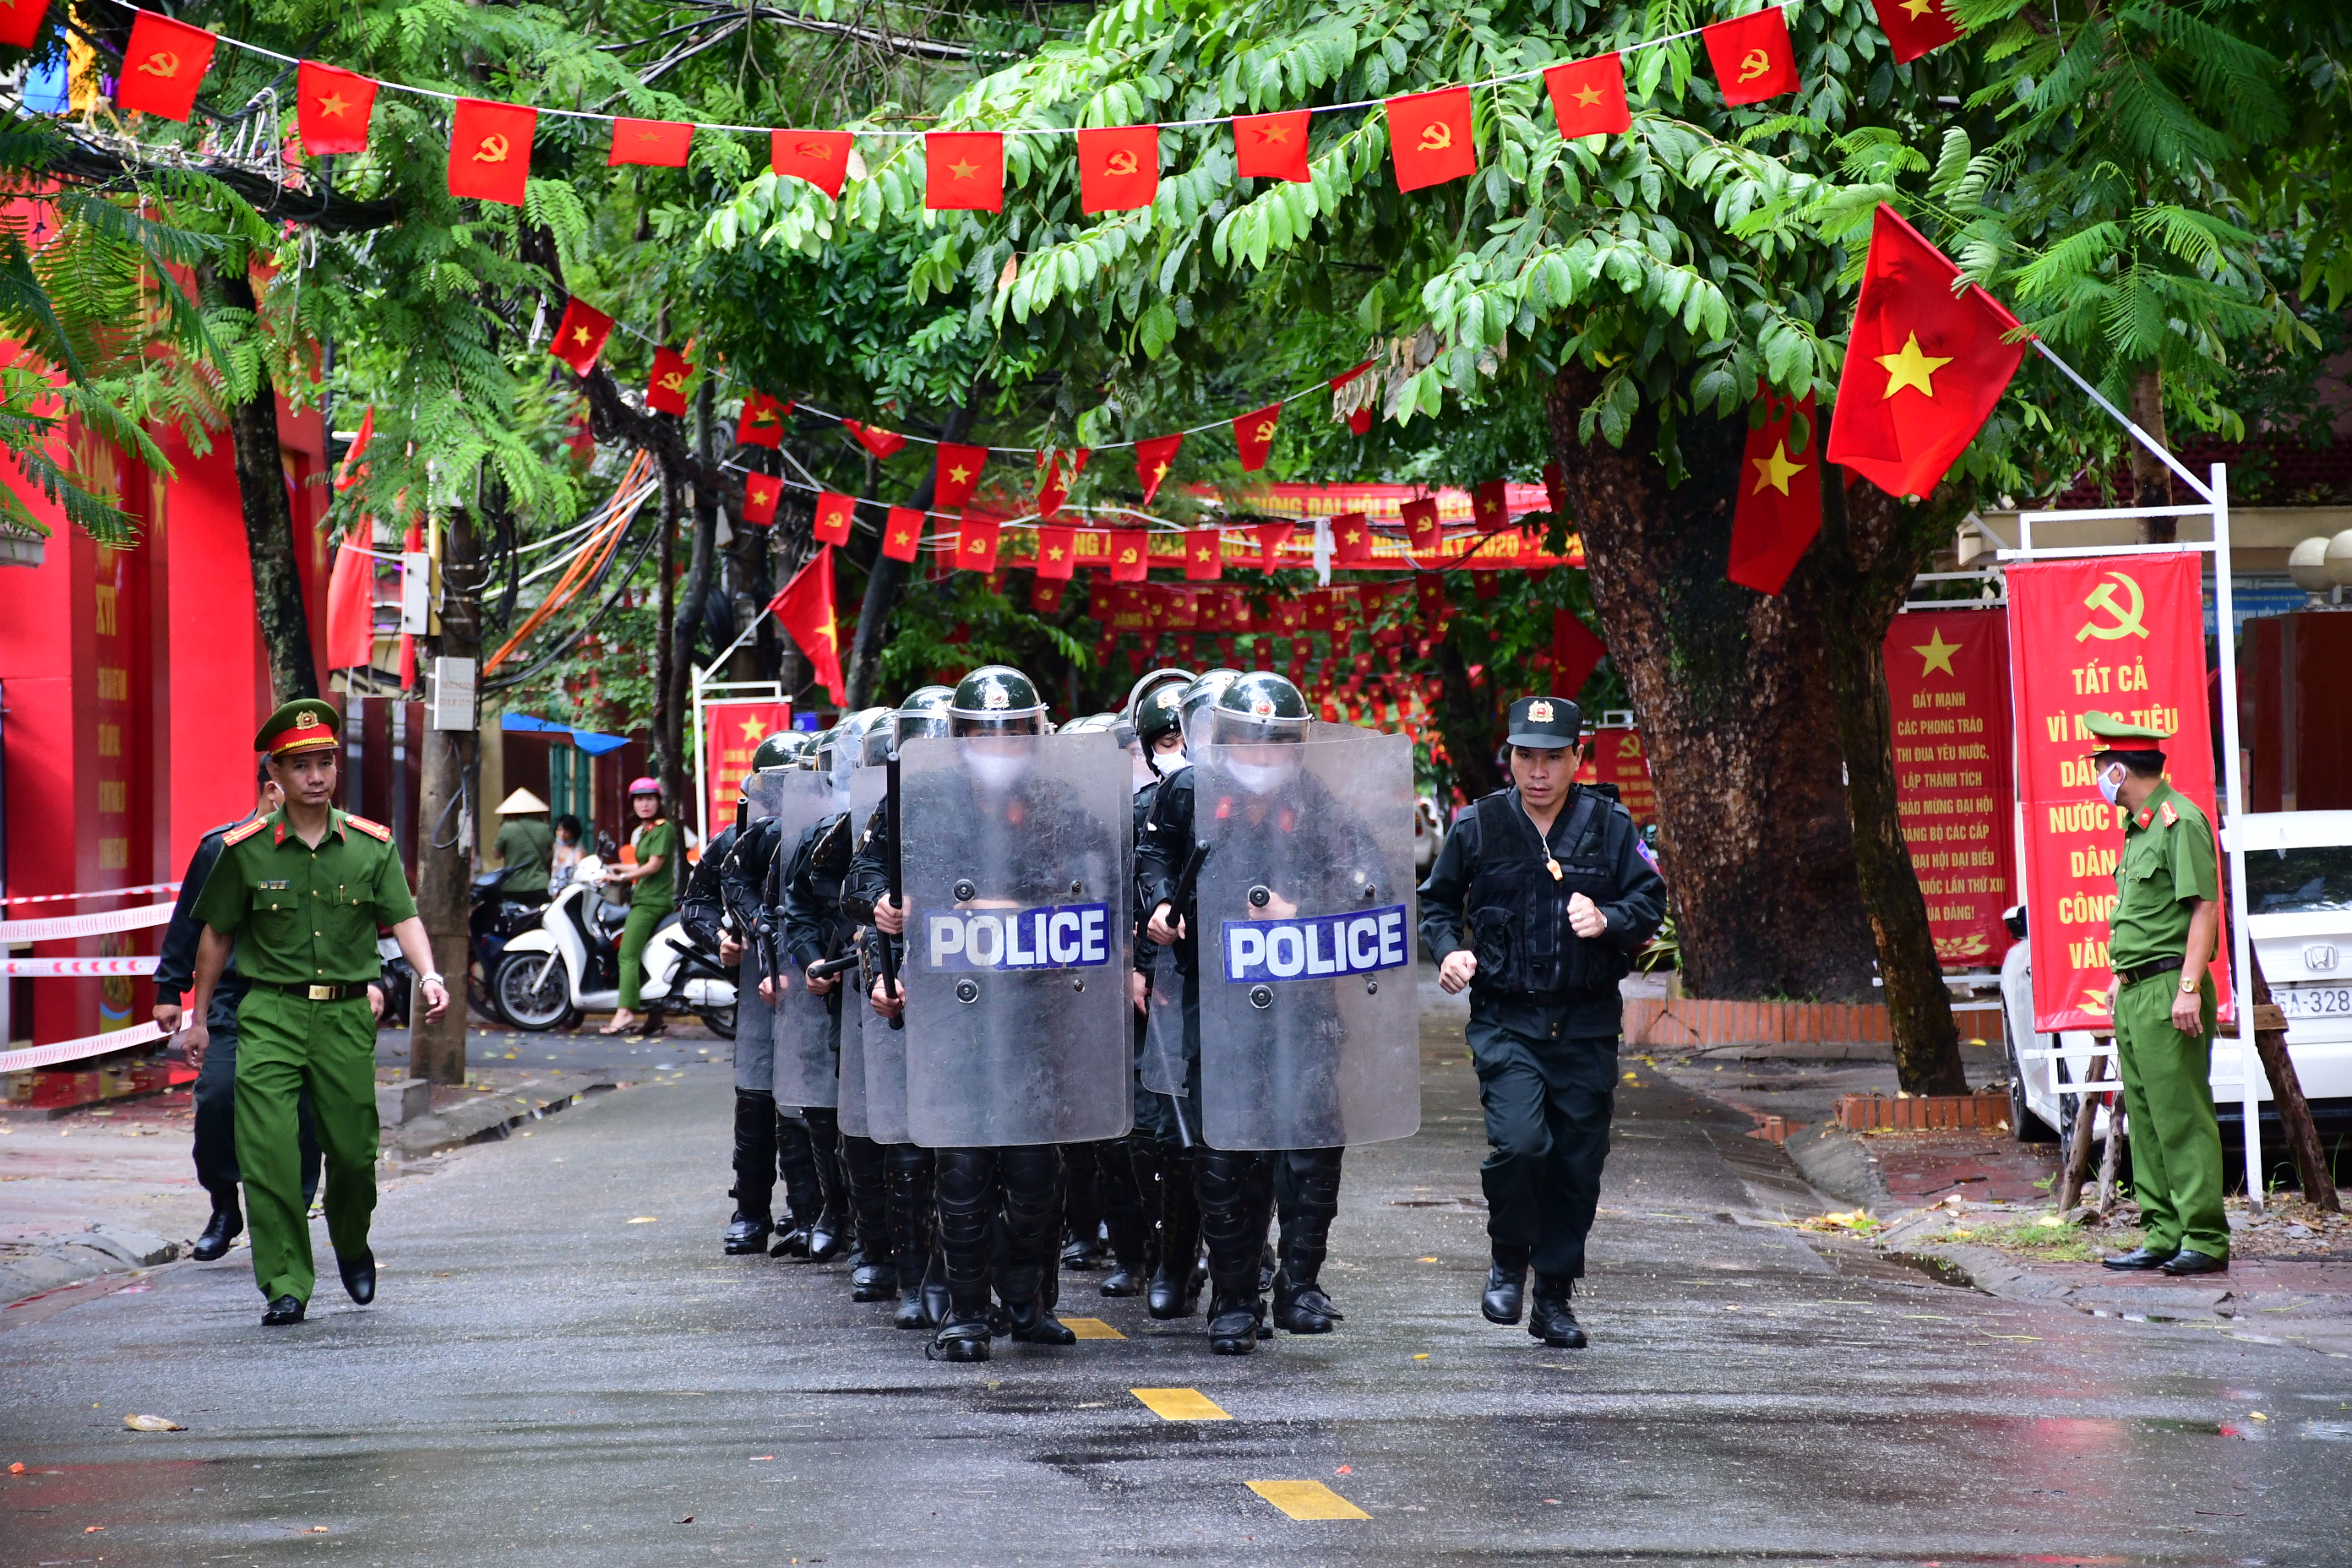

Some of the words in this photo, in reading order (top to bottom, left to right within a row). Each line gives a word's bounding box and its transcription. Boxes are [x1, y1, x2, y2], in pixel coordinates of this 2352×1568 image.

[1471, 534, 1520, 558] 2020
[2072, 657, 2110, 695] TẤT
[2118, 656, 2148, 692] CẢ
[1913, 688, 1932, 708] ĐẨY
[1936, 692, 1966, 710] MẠNH
[1897, 718, 1918, 736] CÁC
[1920, 719, 1955, 735] PHONG
[1957, 715, 1984, 733] TRÀO
[2047, 710, 2068, 742] VÌ
[1897, 747, 1912, 762] THI
[1914, 747, 1934, 762] ĐUA
[1937, 743, 1956, 760] YÊU
[1903, 771, 1921, 792] LẬP
[1924, 770, 1957, 787] THÀNH
[1960, 769, 1983, 787] TÍCH
[1924, 798, 1953, 814] MỪNG
[1957, 798, 1974, 816] ĐẠI
[1976, 795, 1993, 815] HỘI
[2050, 800, 2110, 834] NƯỚC
[1930, 823, 1943, 844] BỘ
[1946, 823, 1967, 841] CÁC
[1969, 819, 1990, 840] CẤP
[1913, 853, 1929, 871] ĐẠI
[1932, 850, 1949, 870] HỘI
[1952, 852, 1968, 870] ĐẠI
[1971, 846, 1995, 866] BIỂU
[2071, 845, 2116, 878] DÂN
[1946, 874, 1965, 894] LẦN
[1968, 875, 1987, 894] THỨ
[1926, 901, 1941, 922] ỦA
[1943, 901, 1975, 921] ĐẢNG!
[929, 909, 1105, 968] POLICE
[1230, 912, 1403, 979] POLICE
[2069, 937, 2110, 970] VĂN
